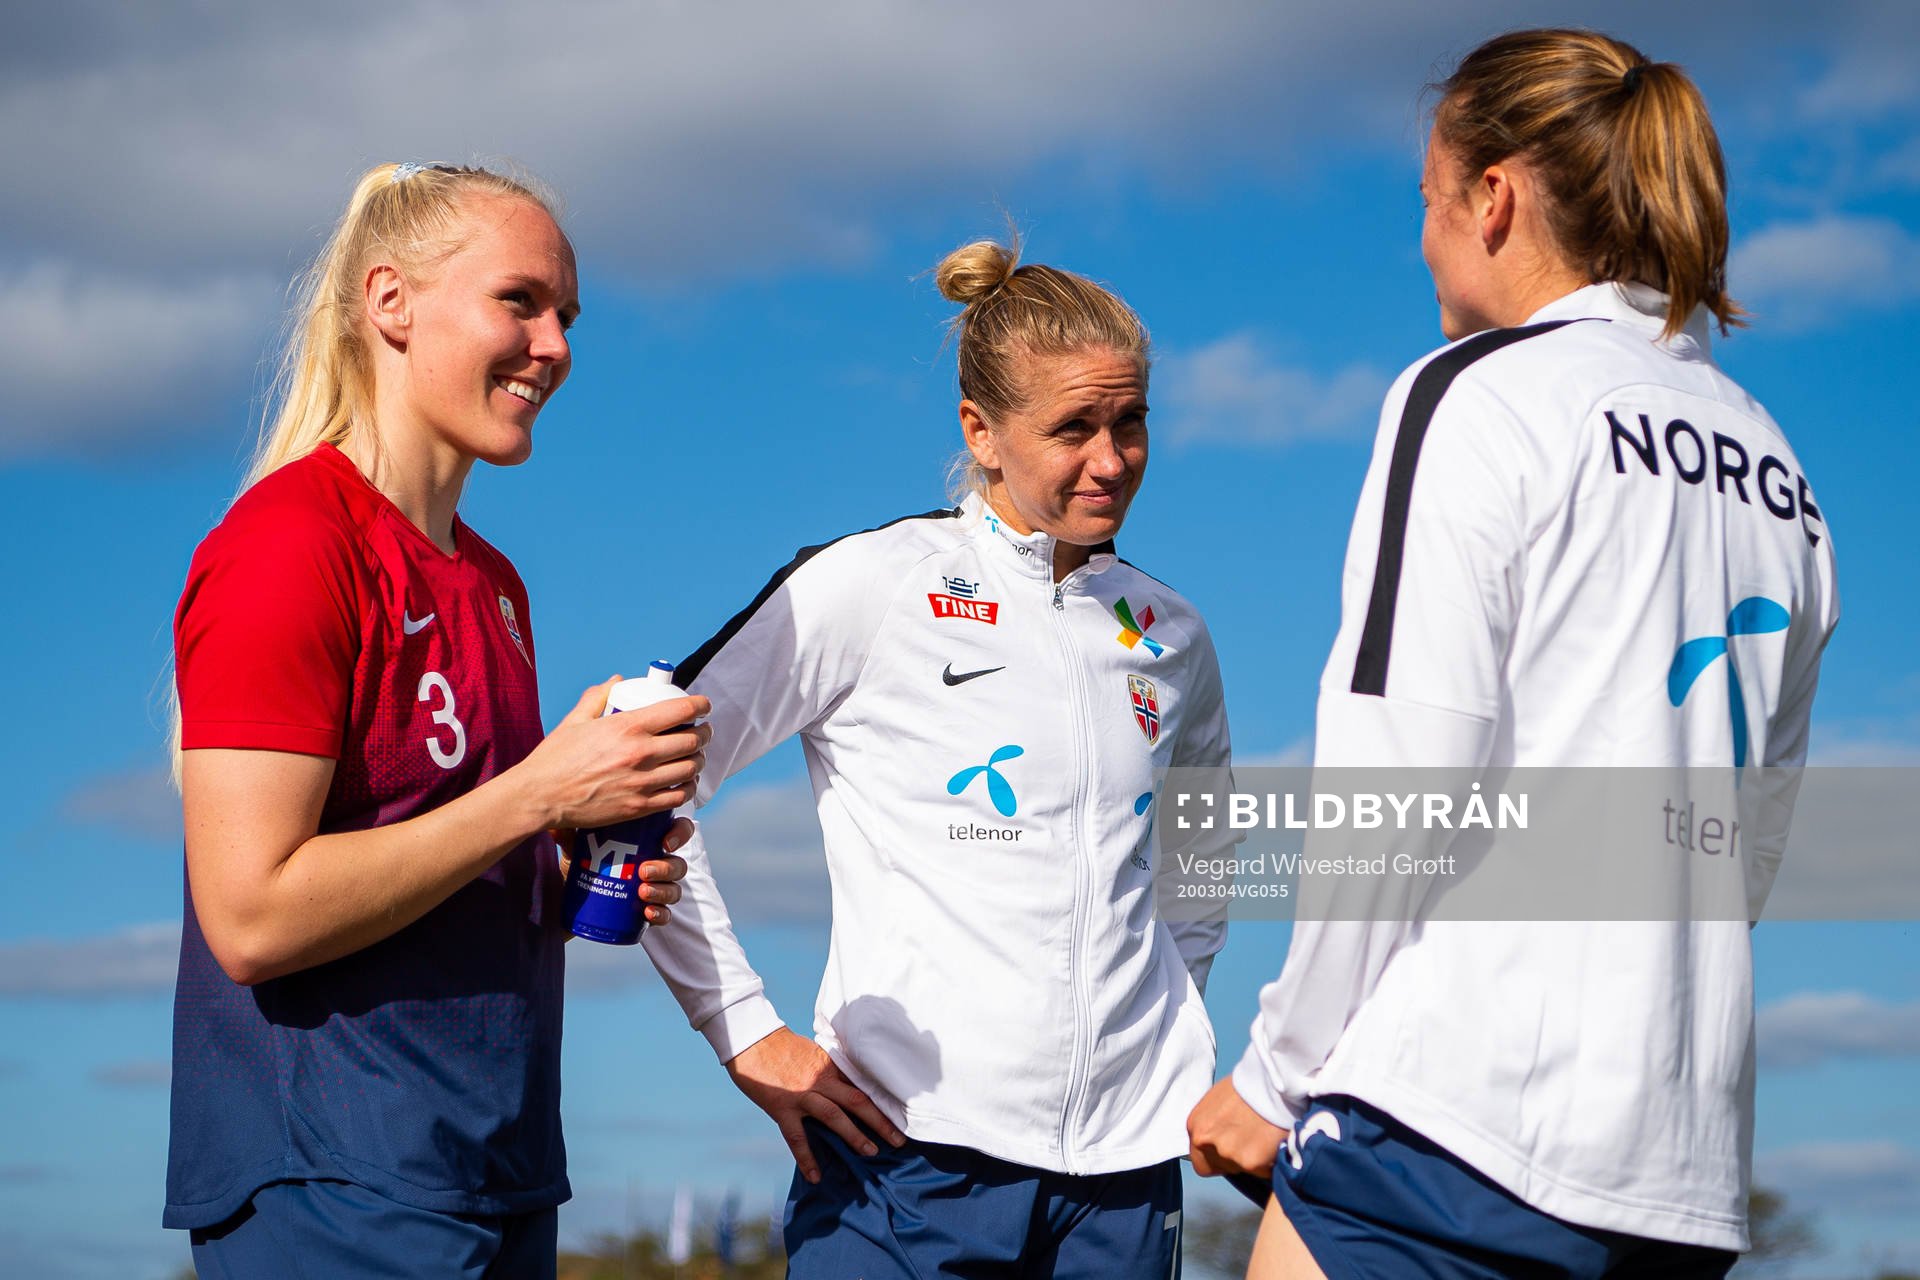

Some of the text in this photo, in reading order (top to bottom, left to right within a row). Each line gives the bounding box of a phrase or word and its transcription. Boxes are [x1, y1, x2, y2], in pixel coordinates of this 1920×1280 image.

[1604, 410, 1822, 548] NORGE
[935, 596, 992, 621] TINE
[418, 671, 466, 769] 3
[948, 823, 1023, 841] telenor
[587, 832, 639, 879] YT
[604, 880, 614, 888] UT
[614, 882, 624, 890] AV
[614, 890, 628, 900] DIN
